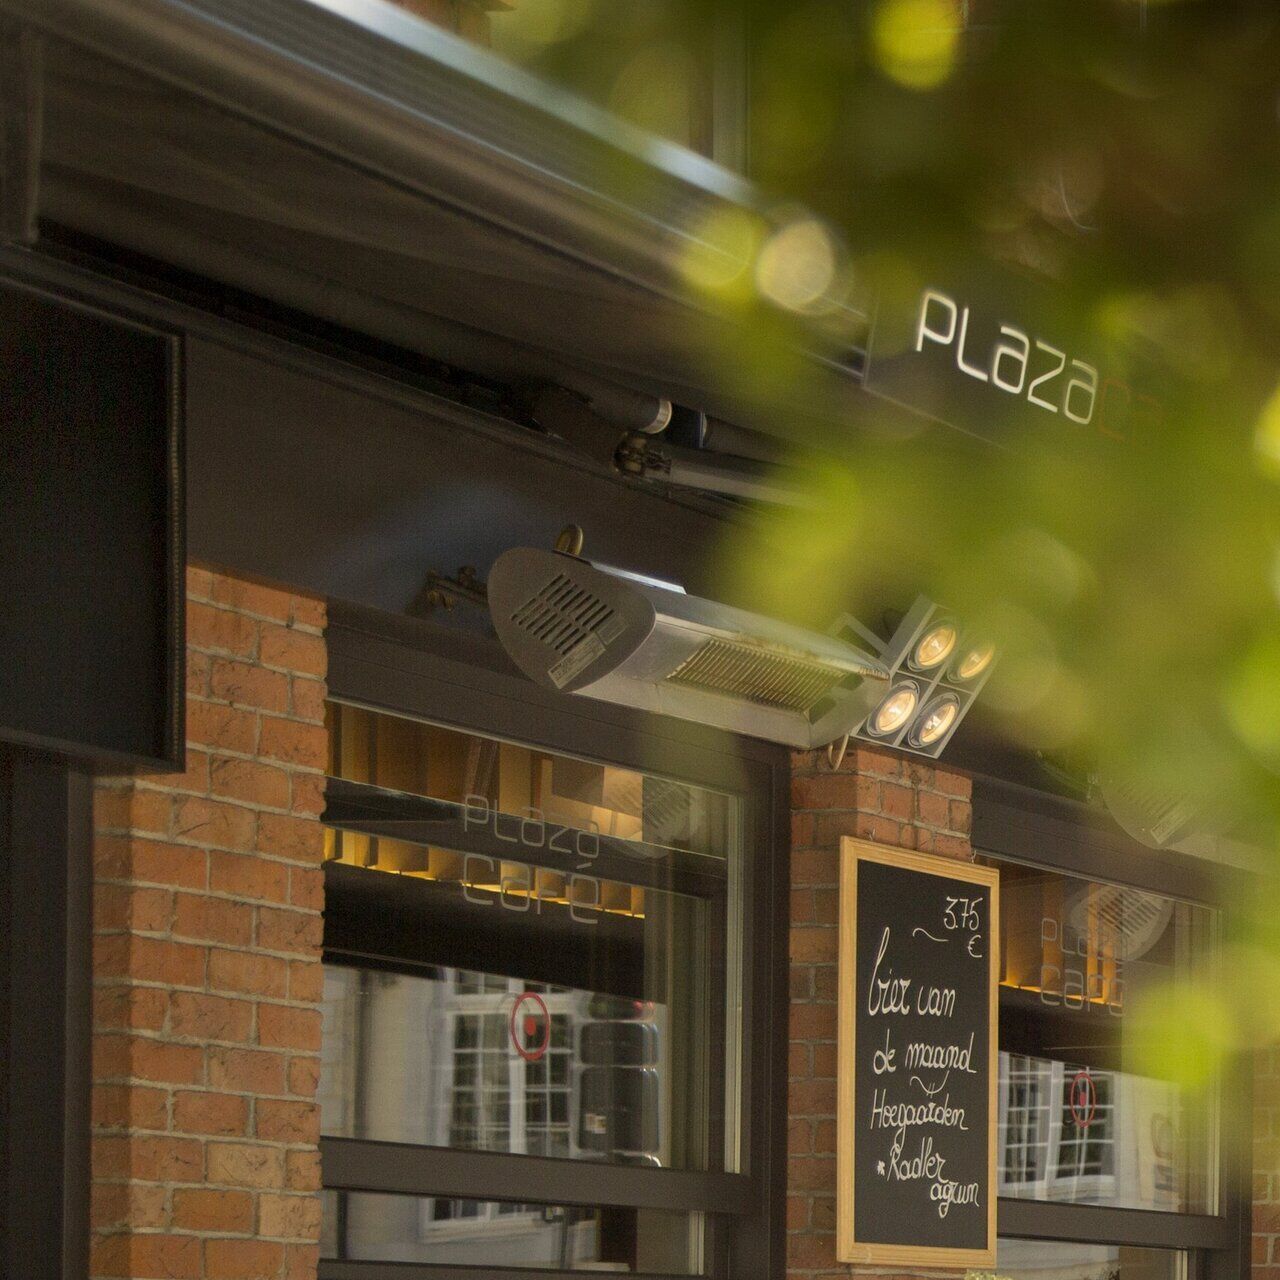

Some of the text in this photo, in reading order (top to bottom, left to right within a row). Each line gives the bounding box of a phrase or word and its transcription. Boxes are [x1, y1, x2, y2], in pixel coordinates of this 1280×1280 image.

[943, 896, 983, 931] 3.75
[967, 934, 983, 958] €
[868, 926, 956, 1017] bier van
[873, 1028, 977, 1075] de maand
[870, 1088, 969, 1154] Hoegaarden
[887, 1136, 950, 1184] Radler
